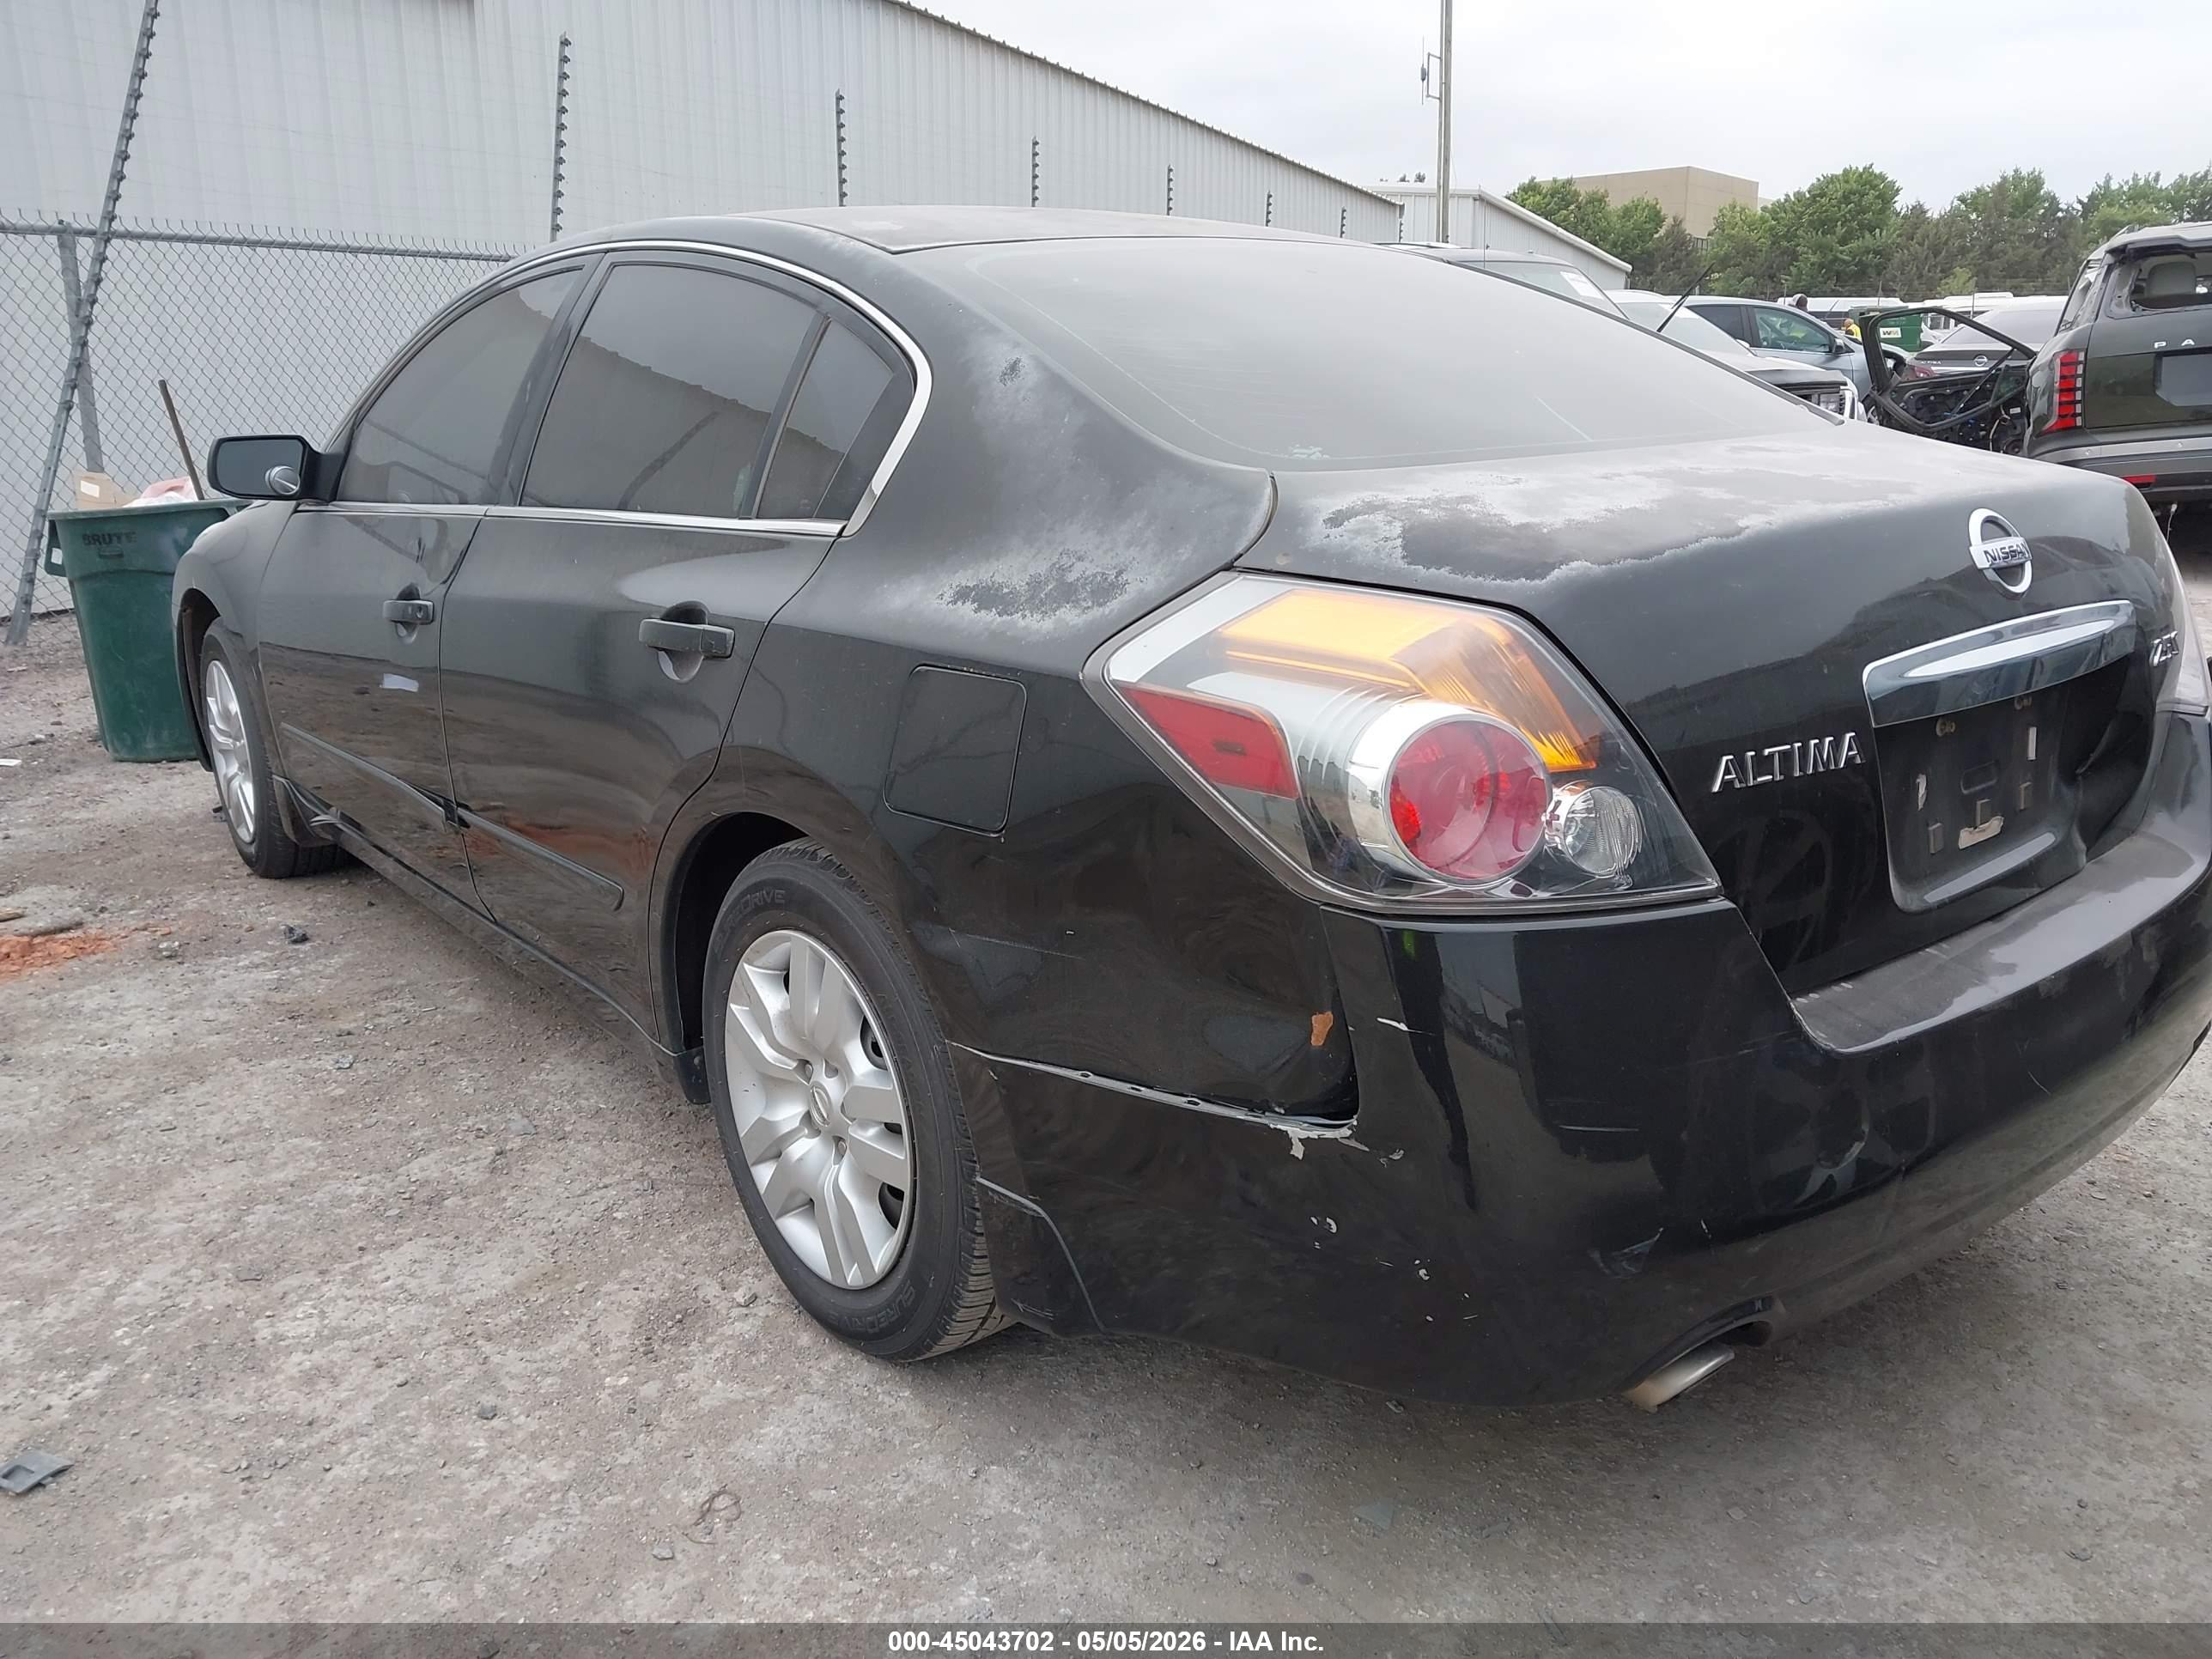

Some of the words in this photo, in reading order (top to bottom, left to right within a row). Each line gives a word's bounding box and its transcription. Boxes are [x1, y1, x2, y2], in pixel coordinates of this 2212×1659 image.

[82, 531, 137, 545] BRUTE
[1983, 542, 2030, 563] NISSAN
[1711, 731, 1867, 793] ALTIMA
